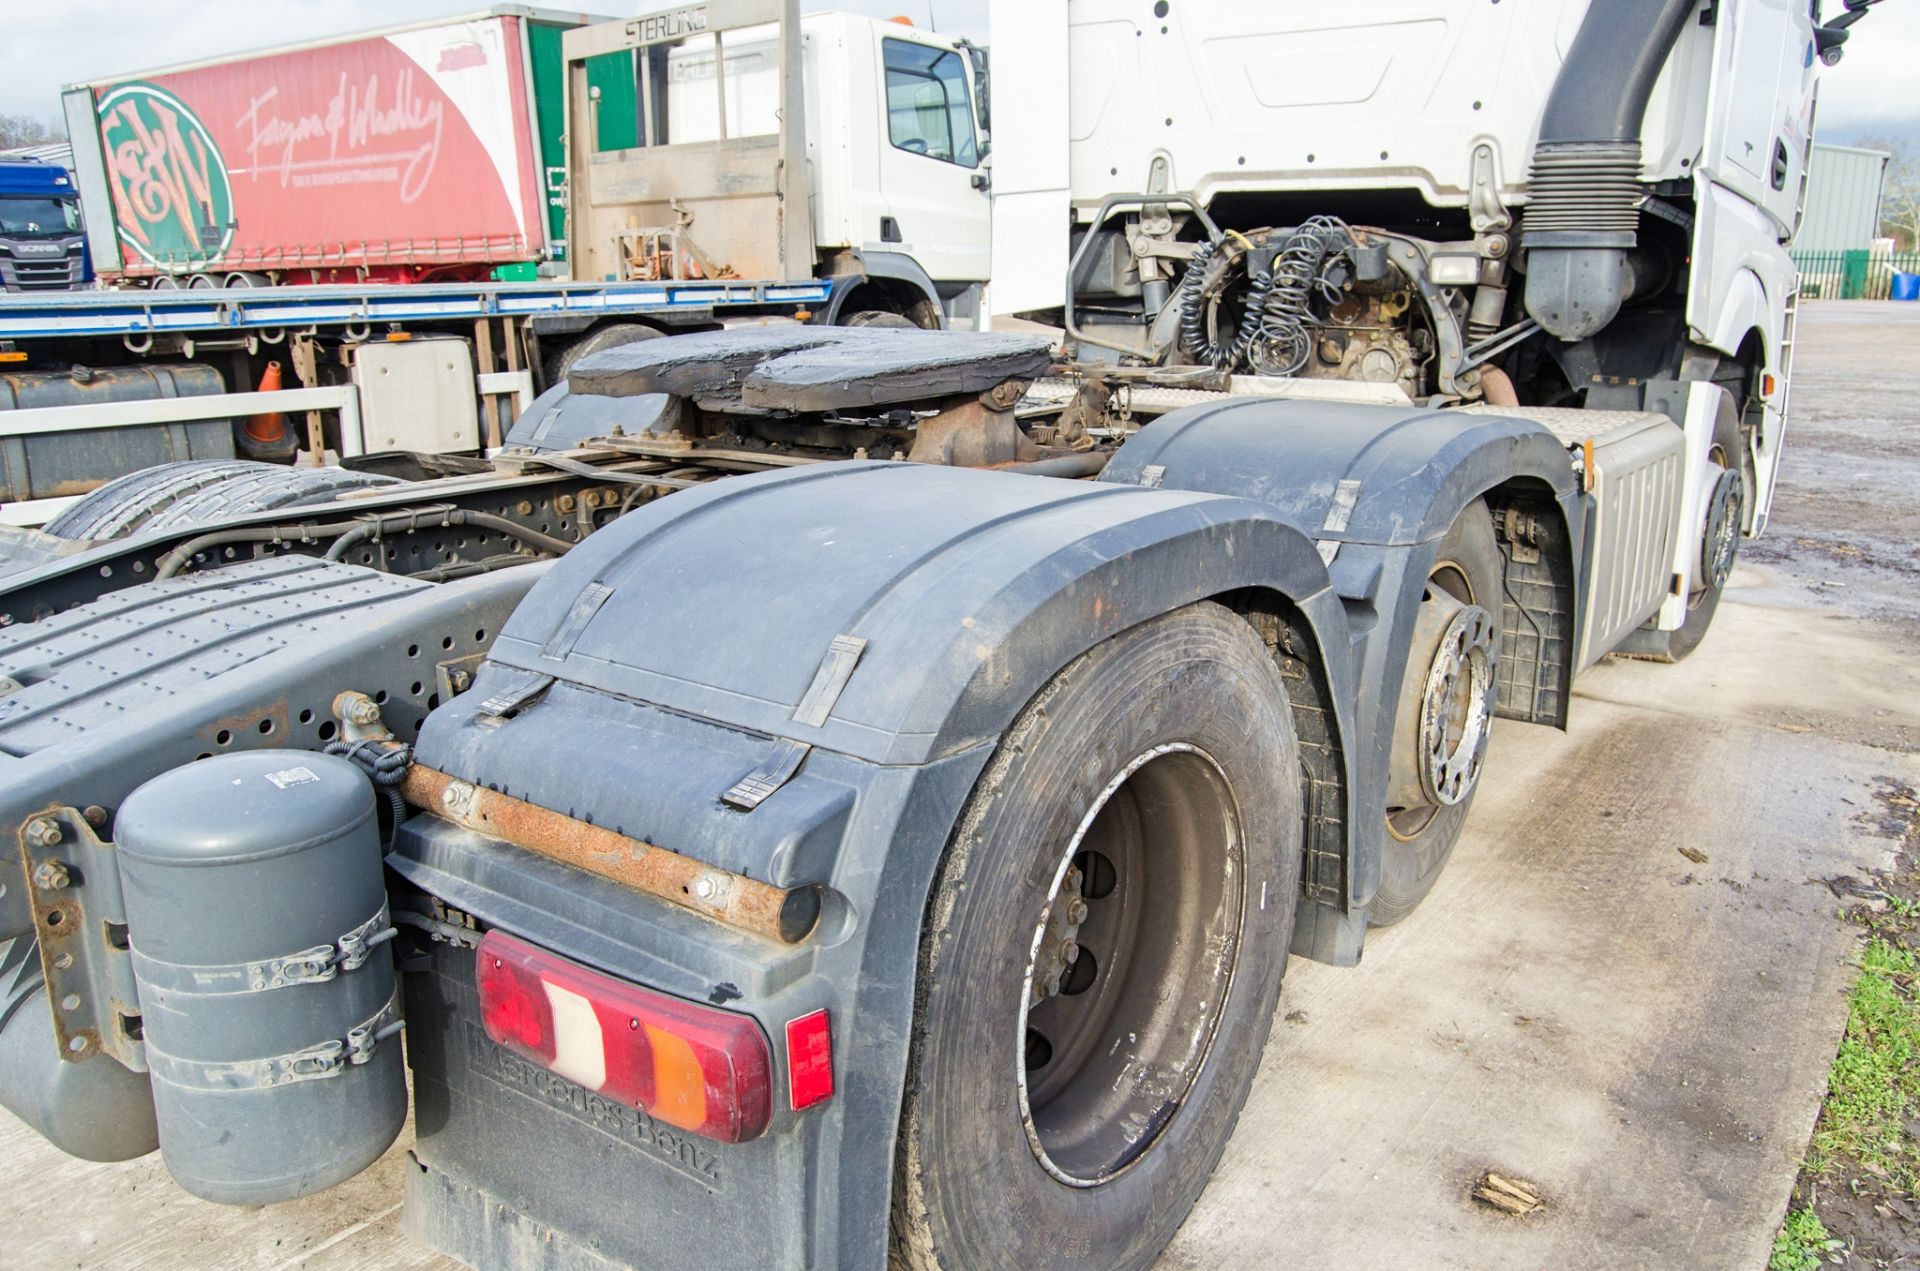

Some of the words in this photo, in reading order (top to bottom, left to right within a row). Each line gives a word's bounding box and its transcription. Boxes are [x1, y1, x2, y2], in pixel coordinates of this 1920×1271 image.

[625, 6, 708, 45] STERLING
[17, 244, 60, 252] SCANIA
[474, 1036, 719, 1180] Mercedes-Benz
